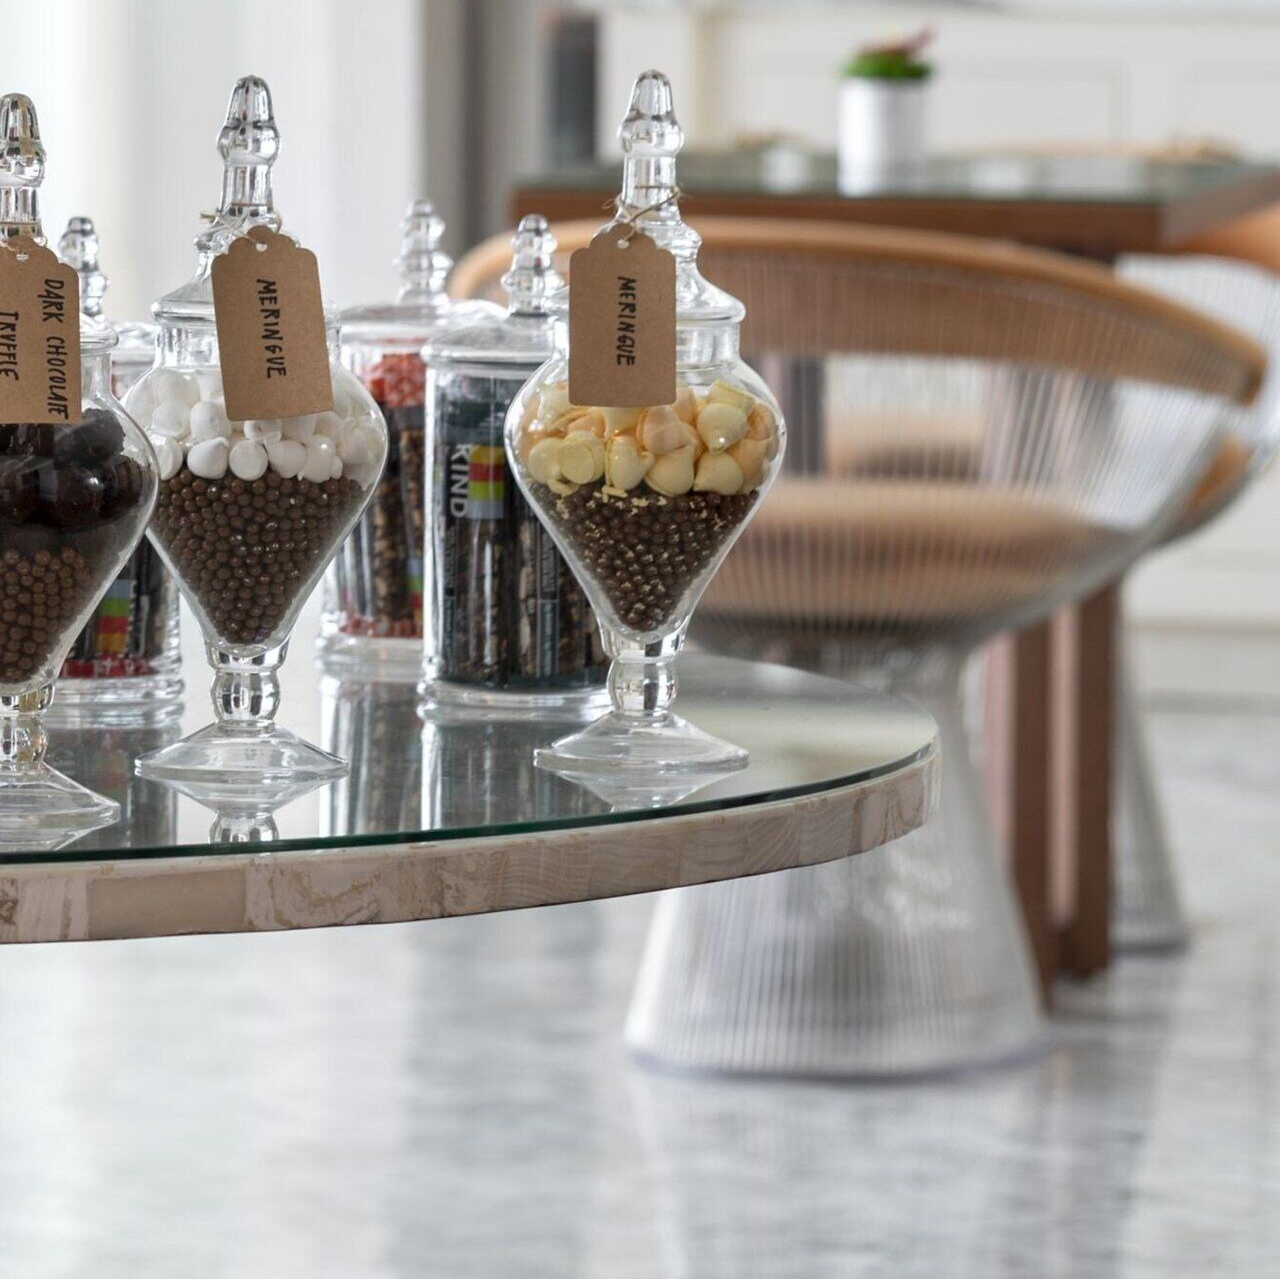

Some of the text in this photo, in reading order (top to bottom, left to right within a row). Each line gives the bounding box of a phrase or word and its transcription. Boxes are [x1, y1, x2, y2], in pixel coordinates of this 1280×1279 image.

[37, 278, 69, 420] DARK CHOCOLATE
[256, 278, 287, 379] MERINGUE
[616, 276, 638, 366] MERINGUE
[450, 443, 472, 518] KIND
